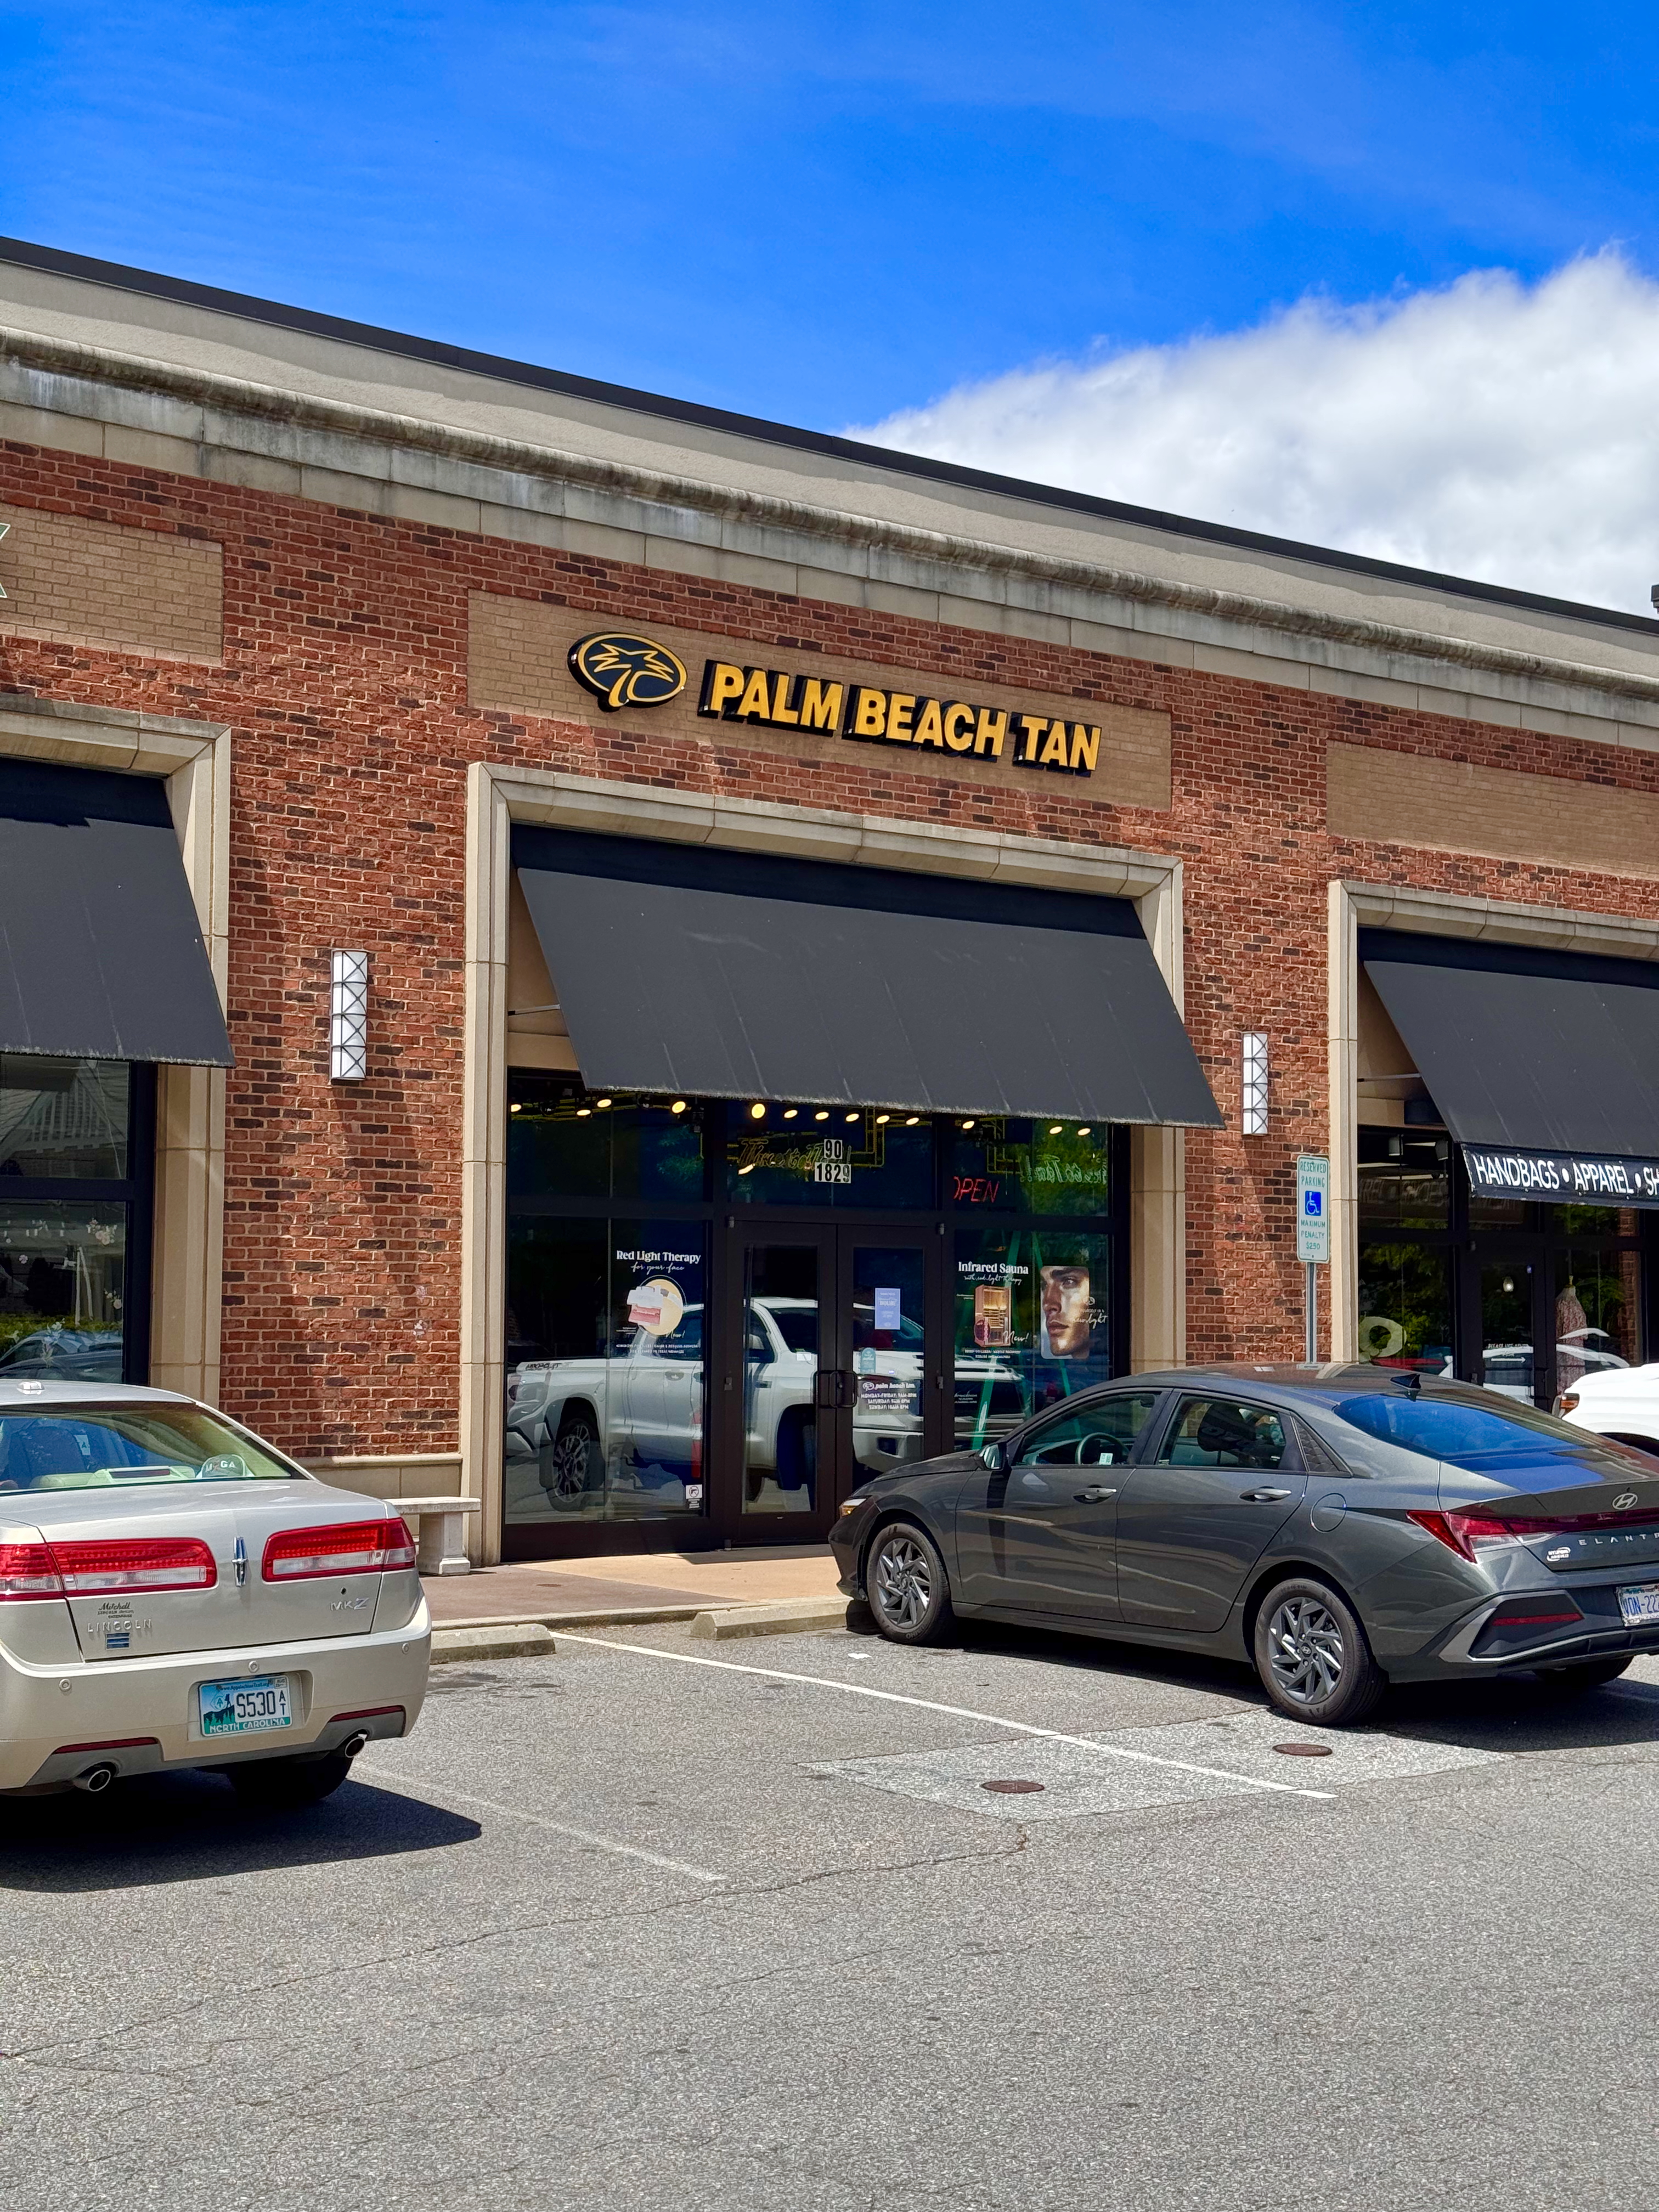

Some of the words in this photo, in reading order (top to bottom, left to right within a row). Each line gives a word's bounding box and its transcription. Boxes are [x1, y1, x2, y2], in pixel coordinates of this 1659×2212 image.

[706, 661, 845, 732] PALM
[850, 686, 1008, 757] BEACH
[1016, 713, 1103, 771] TAN
[825, 1139, 842, 1159] 90
[816, 1163, 850, 1183] 1829
[1300, 1161, 1327, 1174] RESERVED
[1472, 1154, 1560, 1190] HANDBAGS
[1301, 1175, 1325, 1188] PARKING
[1572, 1161, 1634, 1194] APPAREL
[1301, 1219, 1325, 1228] MAXIMUM
[1301, 1230, 1325, 1239] PENALTY
[617, 1250, 635, 1260] Red
[636, 1250, 661, 1262] Light
[662, 1252, 701, 1264] Therapy
[631, 1261, 645, 1273] for
[646, 1265, 665, 1276] your
[665, 1262, 685, 1273] face
[958, 1261, 997, 1273] Infrared
[999, 1263, 1029, 1274] Sauna
[1003, 1330, 1029, 1344] New!
[98, 1602, 131, 1611] Mitchell
[330, 1598, 369, 1611] MKZ
[88, 1618, 151, 1633] LINCOLN
[236, 1690, 276, 1718] S530
[210, 1722, 240, 1734] NORTH
[242, 1718, 285, 1729] CAROLINA
